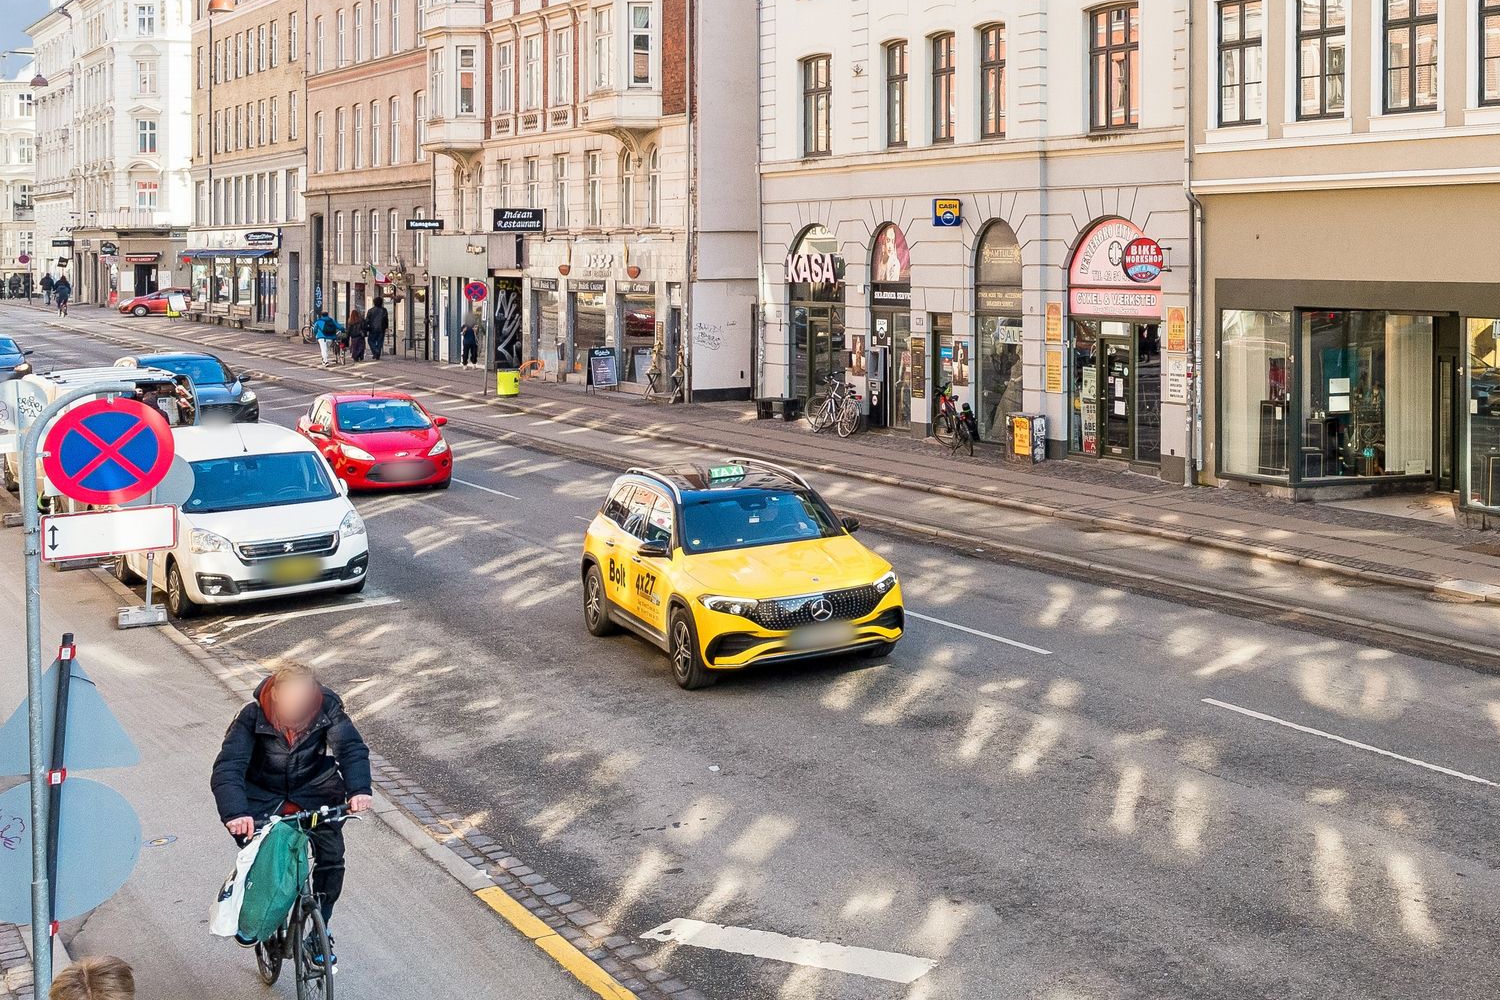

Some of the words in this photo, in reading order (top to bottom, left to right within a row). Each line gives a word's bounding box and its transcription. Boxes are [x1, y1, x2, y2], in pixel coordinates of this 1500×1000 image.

[503, 211, 533, 219] Indian
[497, 220, 541, 229] Restaurant
[1130, 245, 1157, 255] BIKE
[1125, 255, 1162, 264] WORKSHOP
[787, 253, 835, 283] KASA
[1076, 292, 1102, 305] CYKEL
[1104, 293, 1110, 305] &
[1112, 293, 1157, 307] VÆRKSTED
[711, 465, 744, 478] TAXI
[610, 557, 626, 588] Bolt
